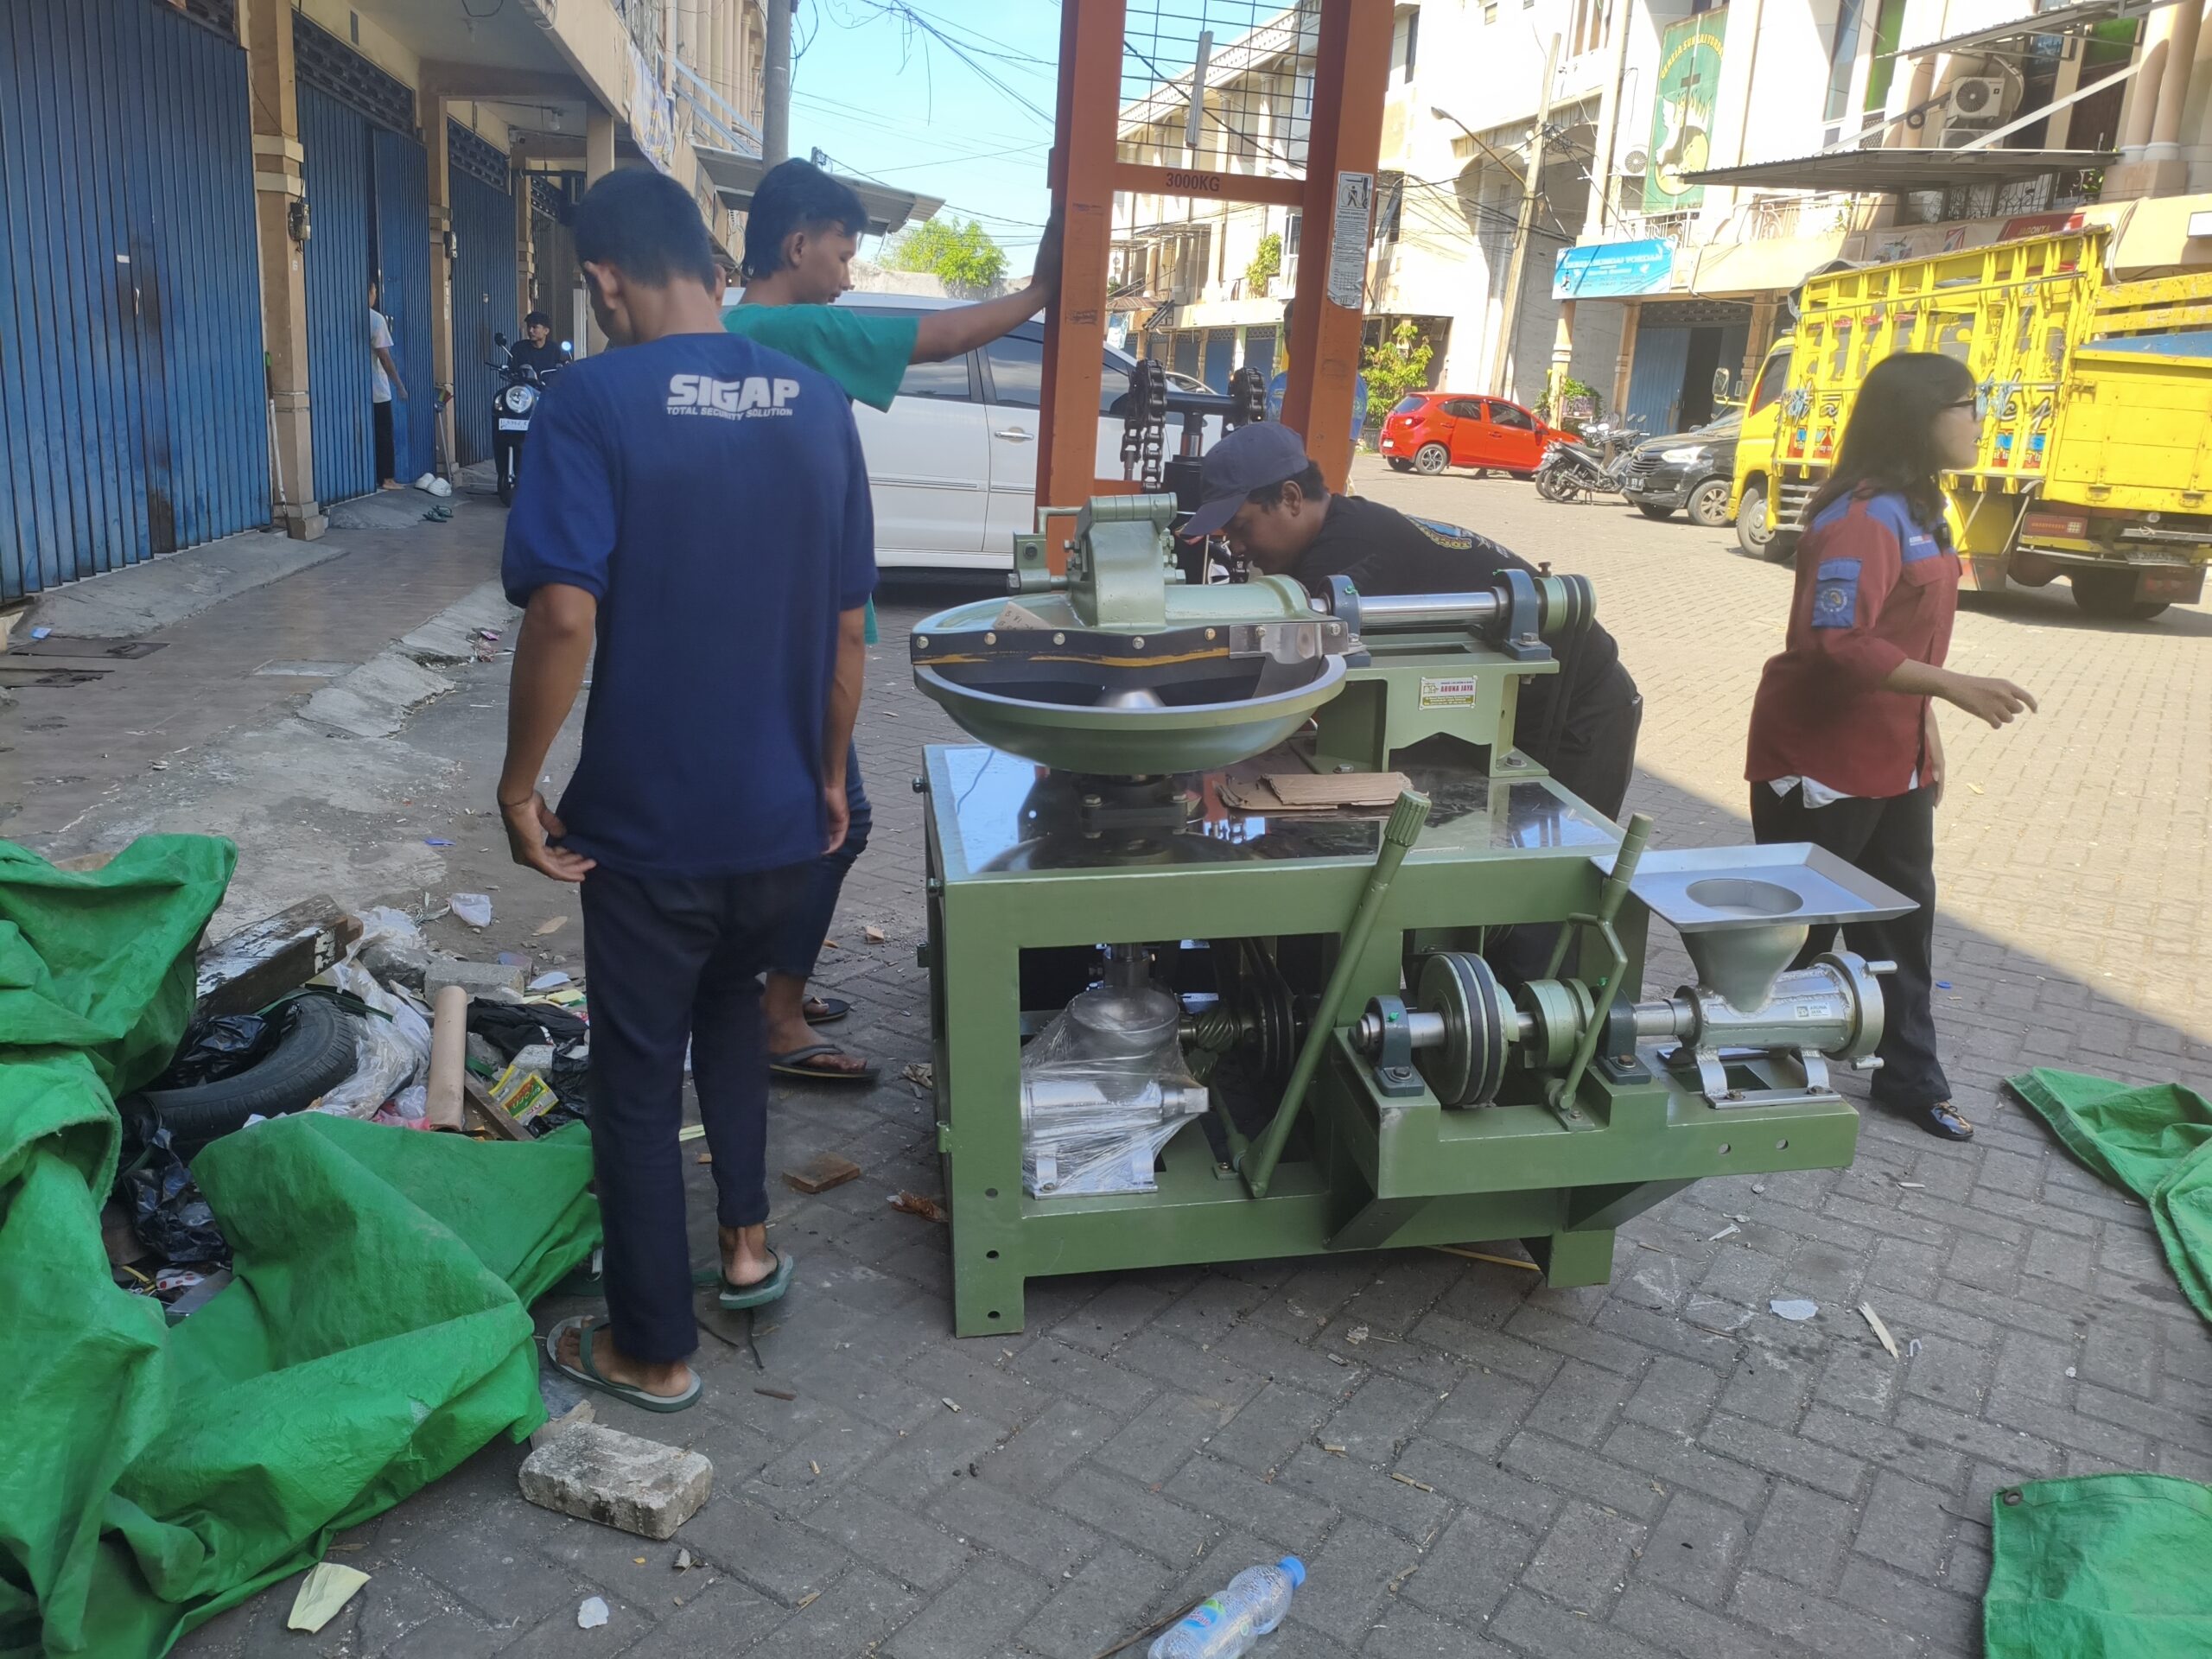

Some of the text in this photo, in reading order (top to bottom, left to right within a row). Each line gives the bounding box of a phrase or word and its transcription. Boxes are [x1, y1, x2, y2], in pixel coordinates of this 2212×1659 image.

[1660, 44, 1683, 79] GEREJA
[1166, 172, 1220, 193] 3000KG
[666, 373, 800, 413] SIGAP
[666, 405, 793, 422] TOTAL SECURITY SOLUTION
